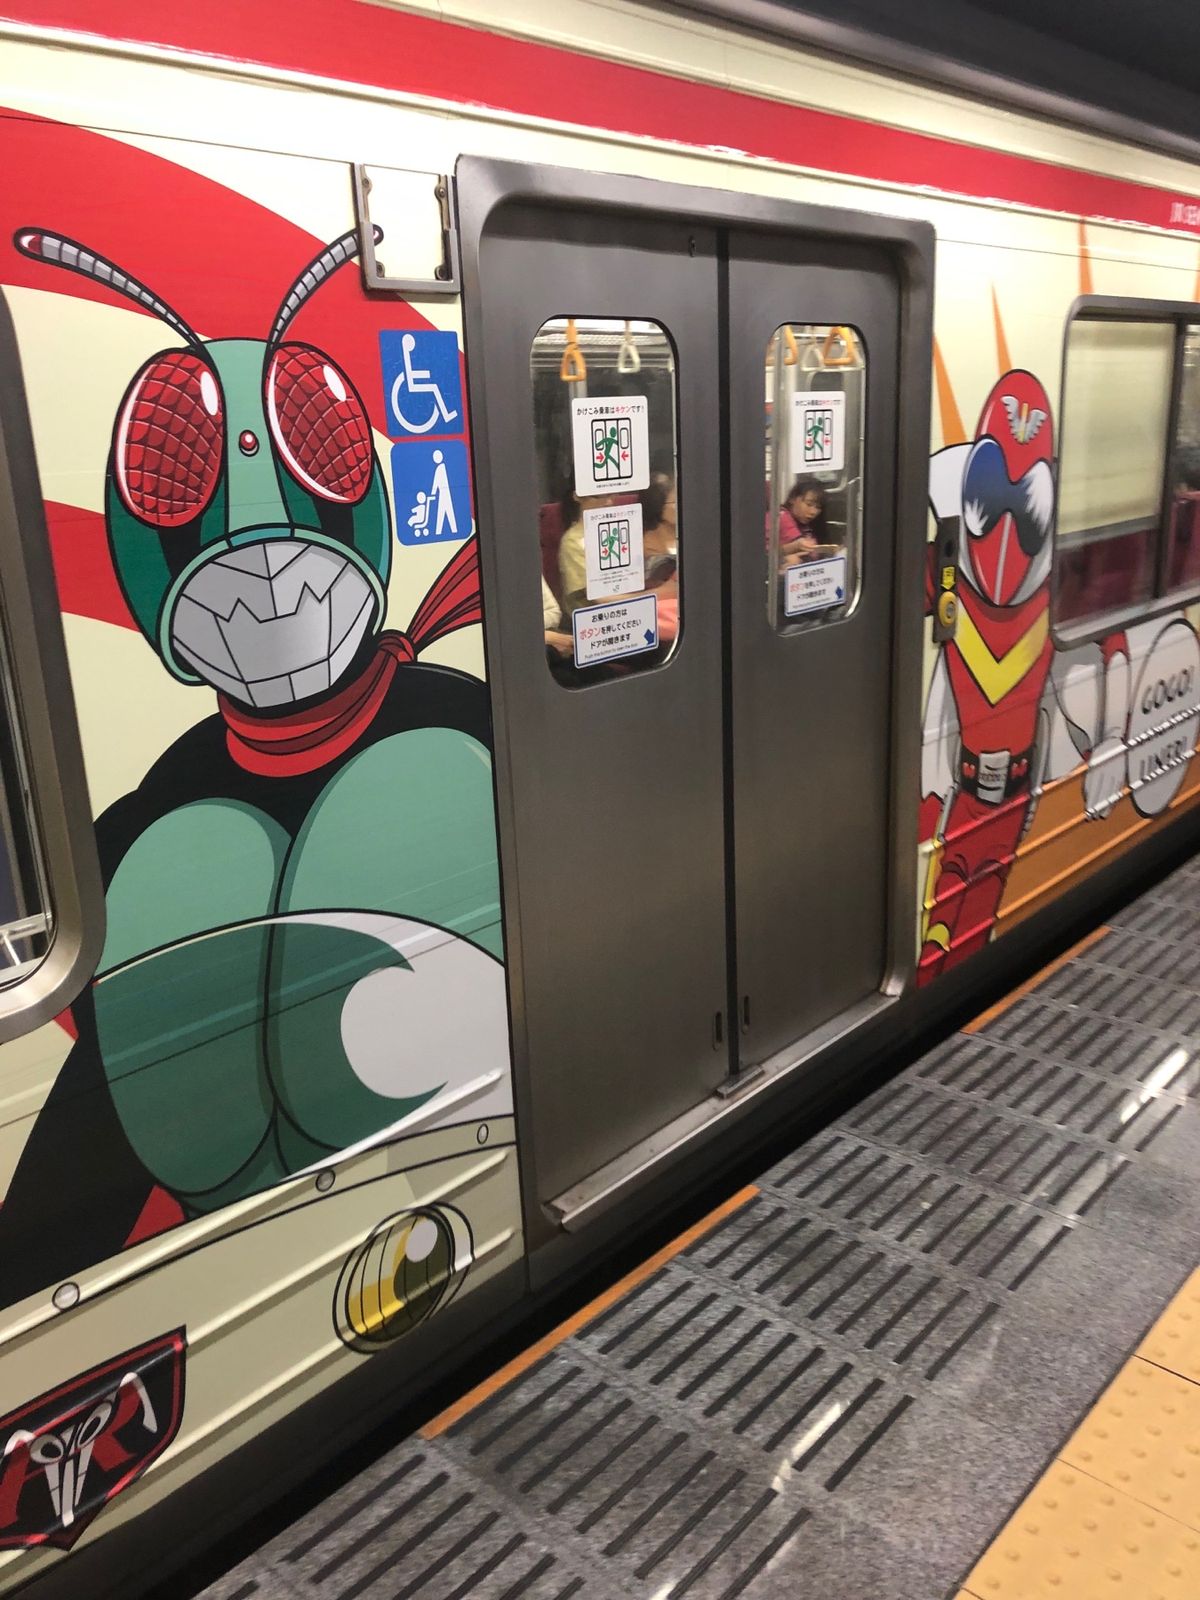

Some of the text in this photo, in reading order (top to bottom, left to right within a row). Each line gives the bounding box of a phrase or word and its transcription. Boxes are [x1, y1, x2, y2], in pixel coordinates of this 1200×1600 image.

[591, 608, 628, 623] お乗りの方は
[580, 618, 642, 640] ボタンを押してください
[590, 633, 631, 650] ドアが開きます
